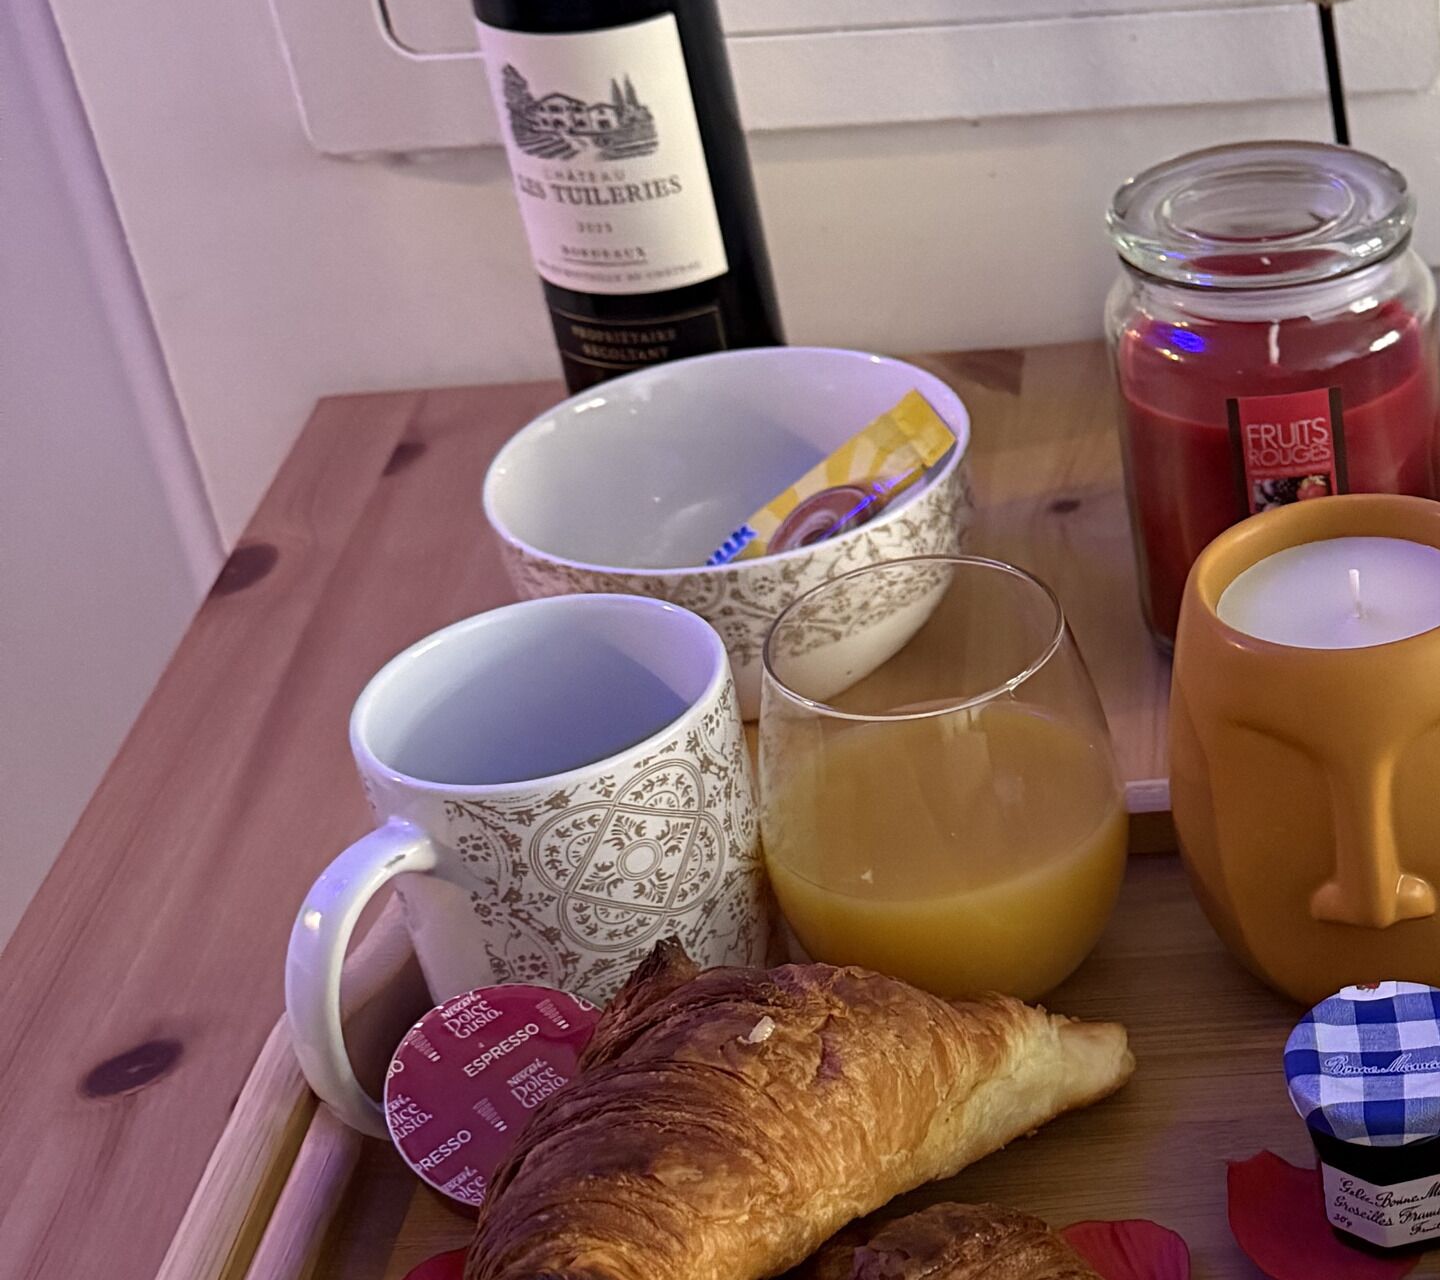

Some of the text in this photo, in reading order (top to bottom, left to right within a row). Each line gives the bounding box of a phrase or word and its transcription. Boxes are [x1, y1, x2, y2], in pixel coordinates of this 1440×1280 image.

[550, 173, 683, 207] TUILERIES
[1246, 417, 1329, 448] FRUITS
[1249, 445, 1331, 466] ROUGES
[444, 999, 492, 1032] Dolce
[455, 1008, 502, 1039] Gusto
[463, 1023, 540, 1078] ESPRESSO
[1325, 1055, 1381, 1075] Bonne
[511, 1066, 558, 1102] Dolce
[521, 1075, 569, 1109] Gusto
